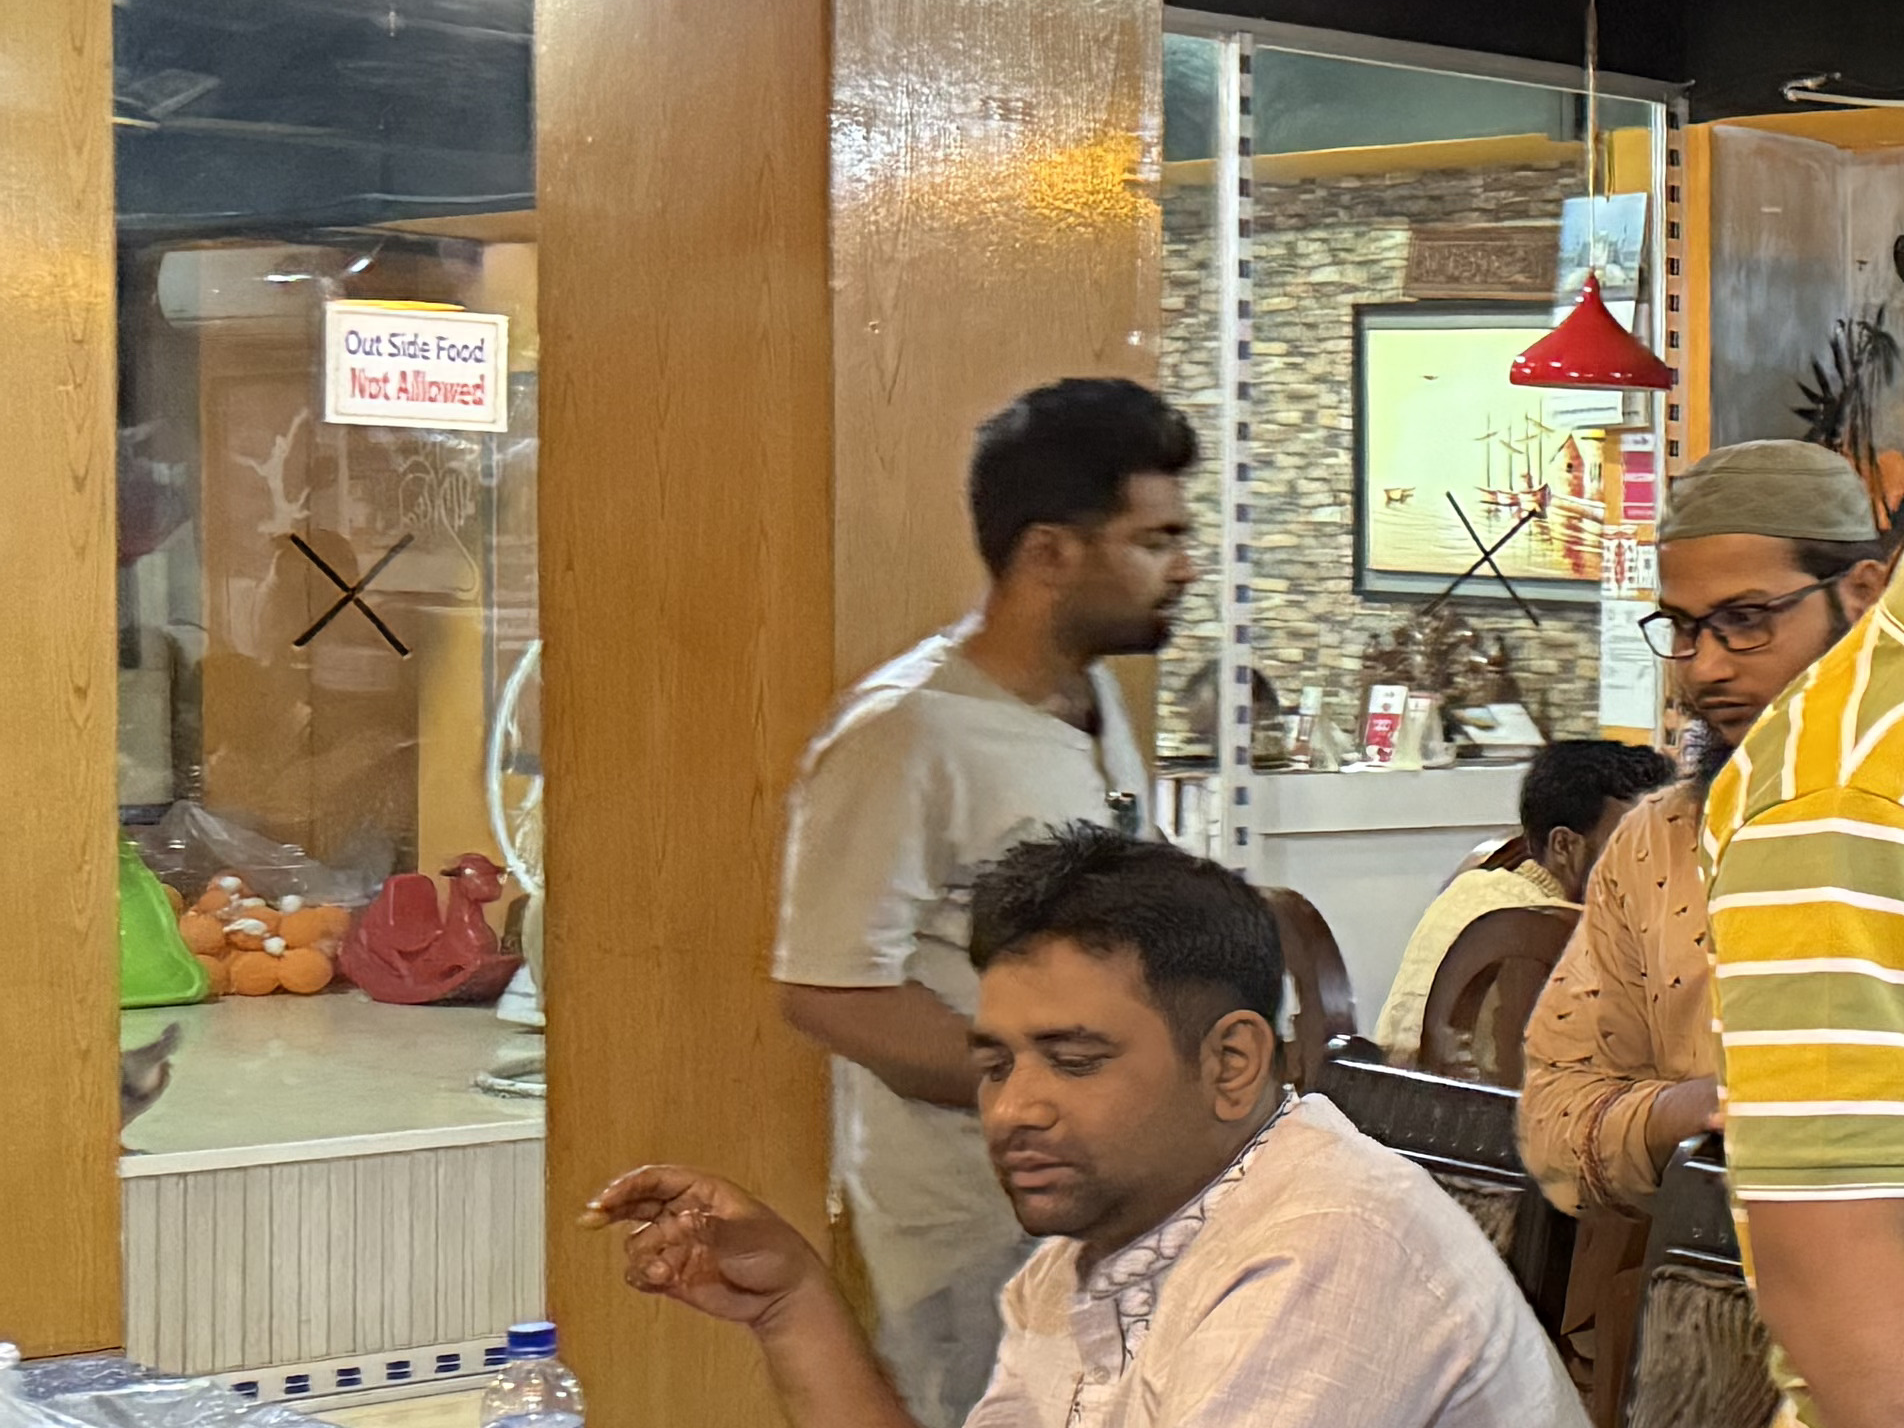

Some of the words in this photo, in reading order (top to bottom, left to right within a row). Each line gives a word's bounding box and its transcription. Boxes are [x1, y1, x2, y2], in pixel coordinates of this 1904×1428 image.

[344, 330, 383, 357] Out
[388, 332, 431, 360] Side
[435, 336, 486, 363] Food
[350, 367, 391, 402] Not
